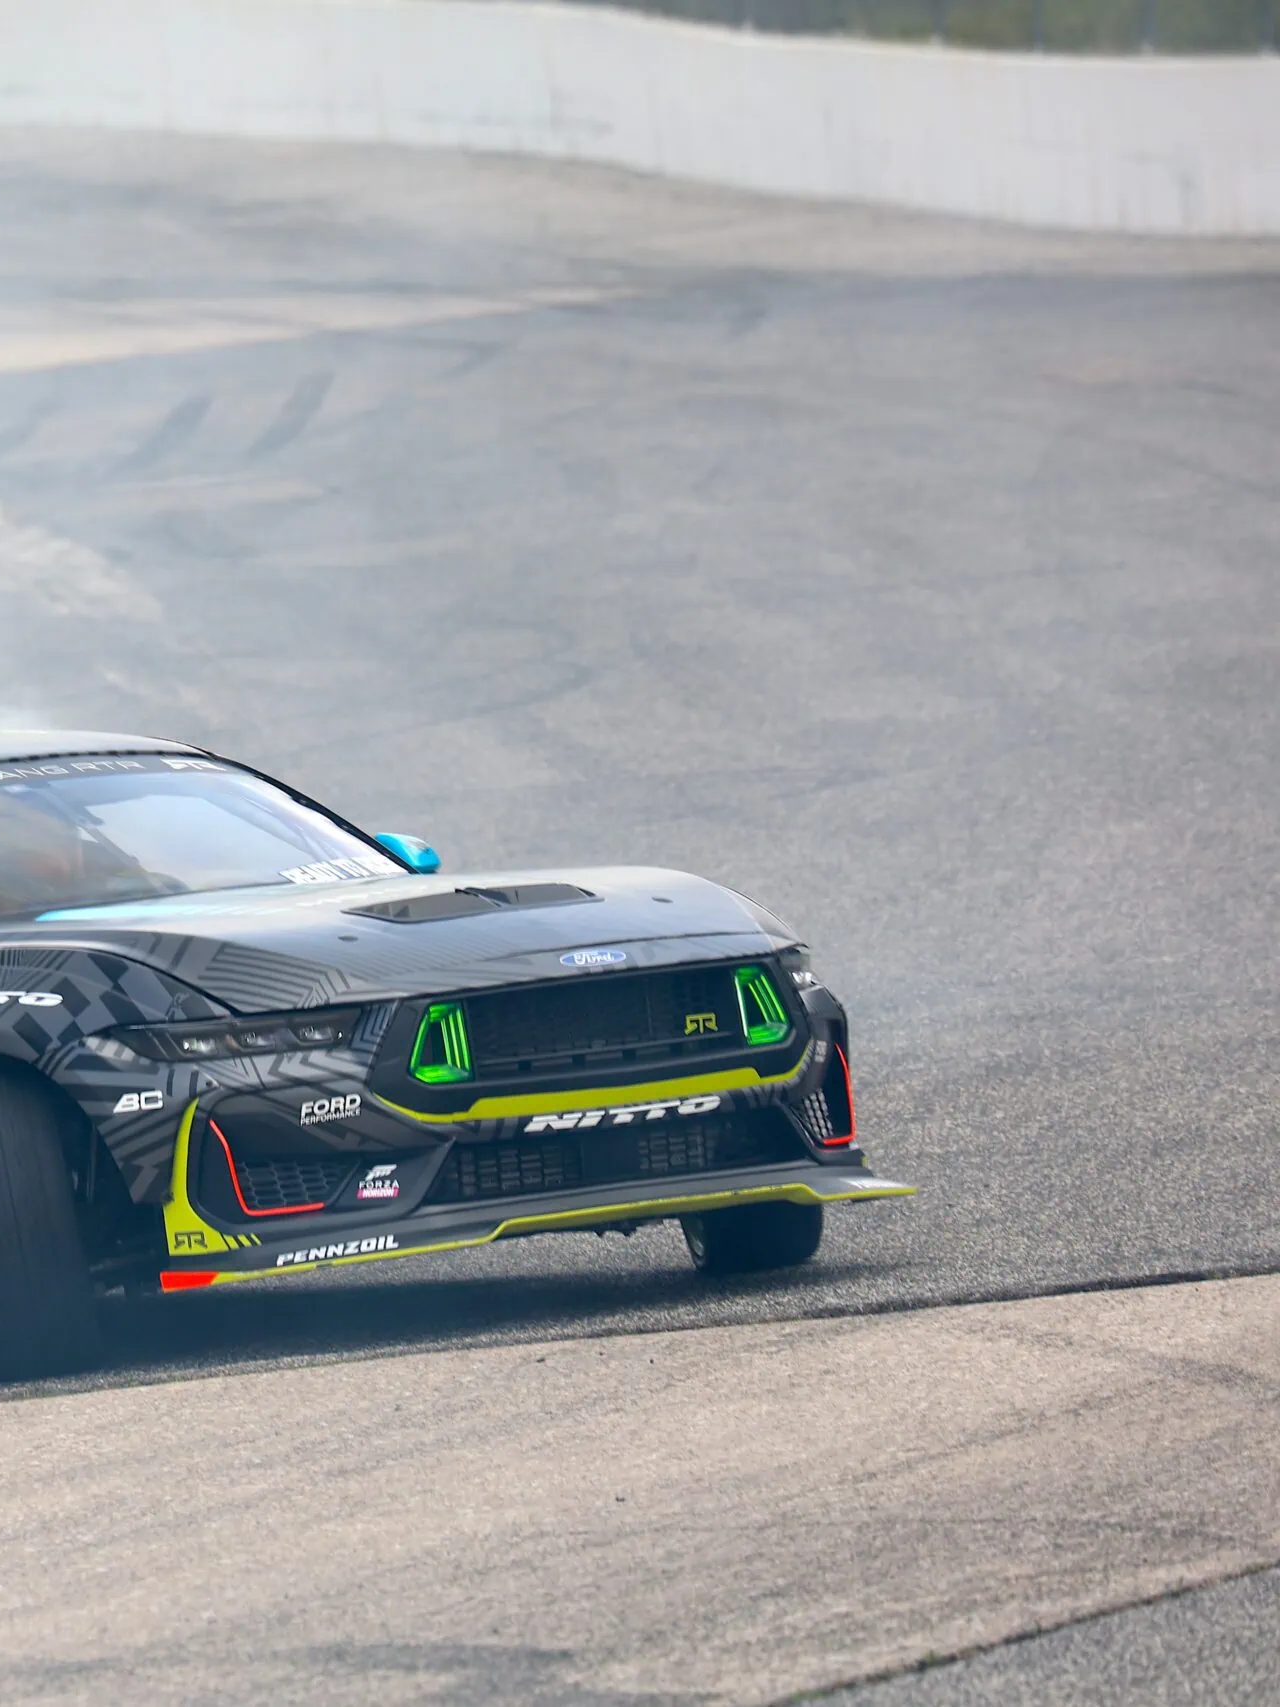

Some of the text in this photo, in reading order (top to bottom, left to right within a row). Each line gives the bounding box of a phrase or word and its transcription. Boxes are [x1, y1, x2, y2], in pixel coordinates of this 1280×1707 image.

[70, 759, 146, 773] RTR
[572, 951, 616, 966] Ford
[301, 1094, 362, 1117] FORD
[523, 1095, 722, 1134] NITTO
[300, 1107, 362, 1127] PERFORMANCE
[359, 1179, 400, 1189] FORZA
[275, 1234, 400, 1267] PENNZOIL
